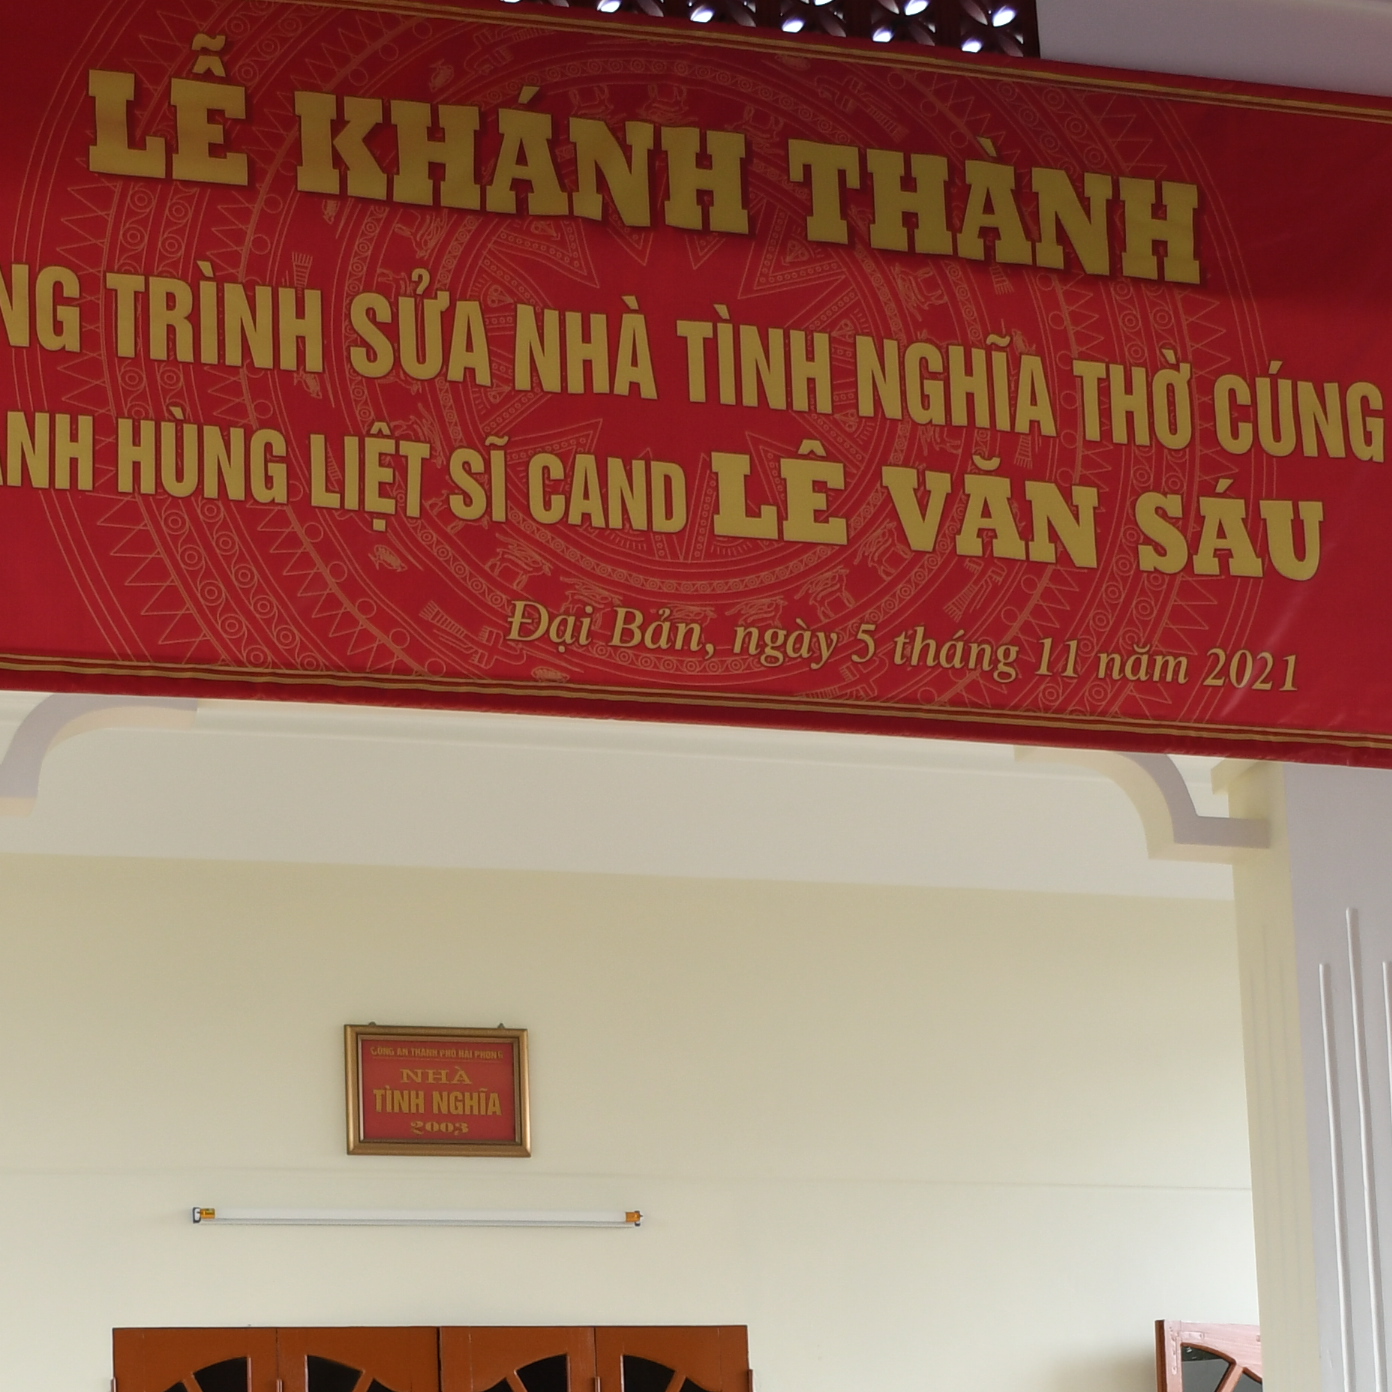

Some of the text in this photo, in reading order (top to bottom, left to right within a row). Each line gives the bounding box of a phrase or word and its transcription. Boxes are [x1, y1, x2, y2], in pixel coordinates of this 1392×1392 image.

[88, 33, 1201, 285] LỄ KHÁNH THÀNH
[106, 260, 324, 374] TRÌNH
[349, 267, 493, 388] SỬA
[514, 296, 659, 400] NHÀ
[676, 304, 834, 415] TÌNH
[855, 333, 1058, 437] NGHĨA
[1072, 347, 1194, 450] THỜ
[1213, 359, 1386, 464] CÚNG
[116, 407, 289, 504] HÙNG
[309, 421, 432, 532] LIỆT
[448, 434, 507, 523] SĨ
[527, 452, 688, 534] CAND
[711, 439, 849, 546] LÊ
[881, 454, 1100, 570] VĂN
[1134, 477, 1325, 582] SÁU
[506, 599, 1300, 692] Đại Bản, ngày 5 tháng 11 năm 2021
[373, 1085, 502, 1116] TÌNH NGHĨA
[400, 1066, 472, 1085] NHÀ
[410, 1120, 469, 1135] 2003
